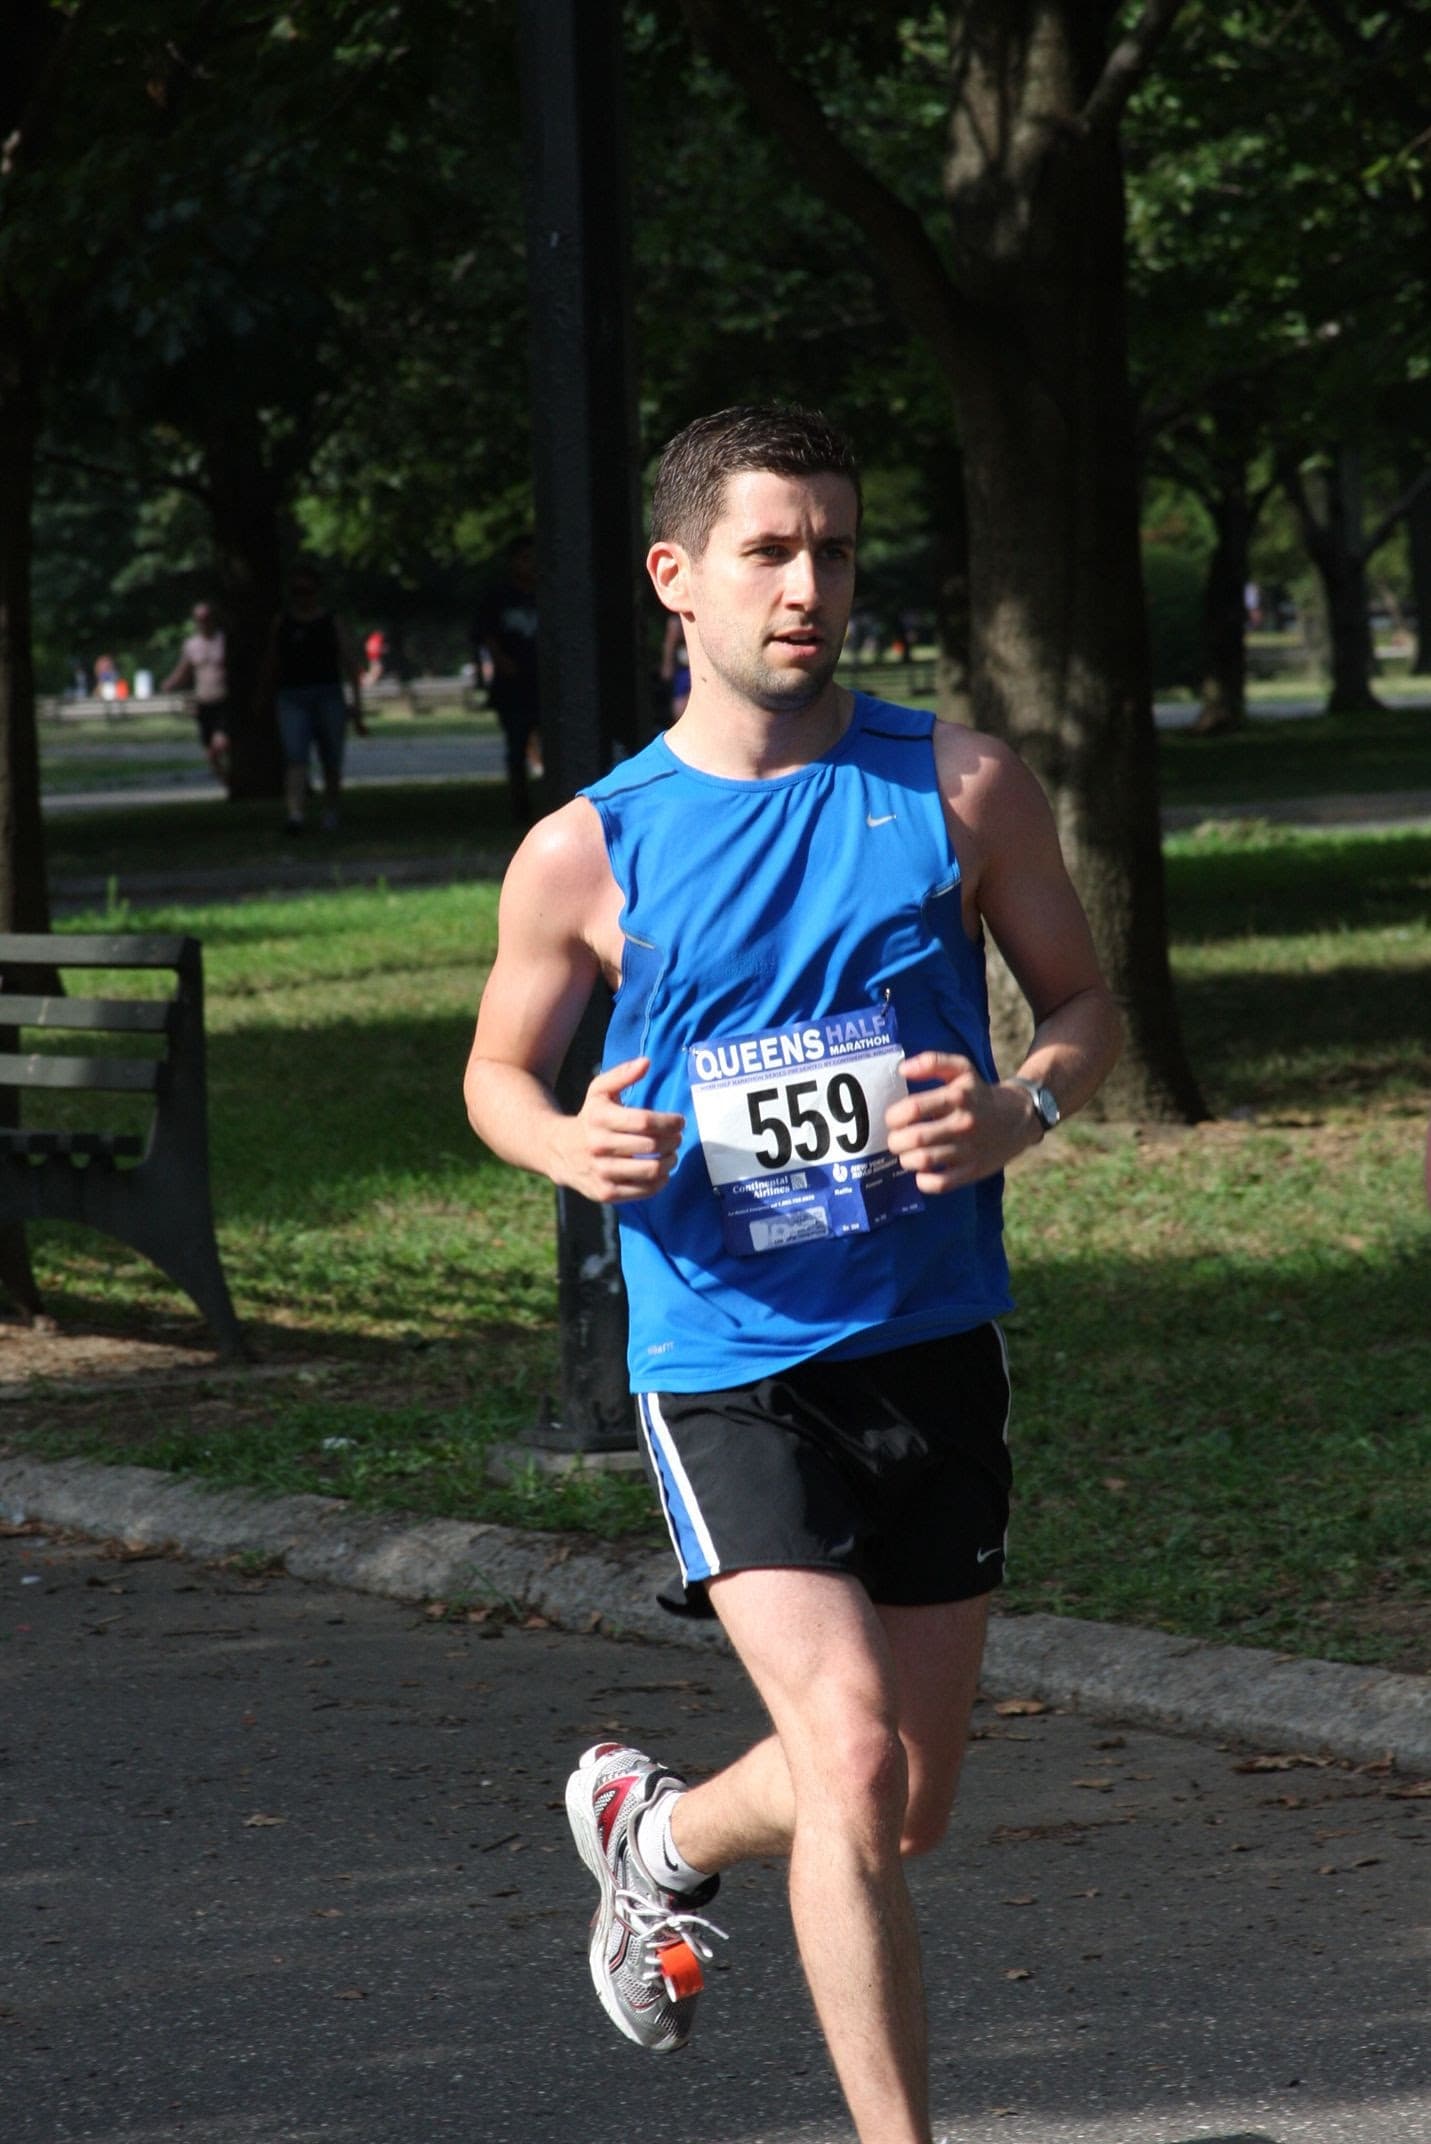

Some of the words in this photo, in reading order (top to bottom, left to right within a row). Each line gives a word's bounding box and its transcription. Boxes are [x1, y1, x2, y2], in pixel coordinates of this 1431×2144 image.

[695, 1029, 824, 1081] QUEENS
[826, 1015, 885, 1044] HALF
[829, 1034, 890, 1056] MARATHON
[746, 1072, 870, 1170] 559
[733, 1176, 789, 1194] Continental
[753, 1186, 791, 1199] Airlines
